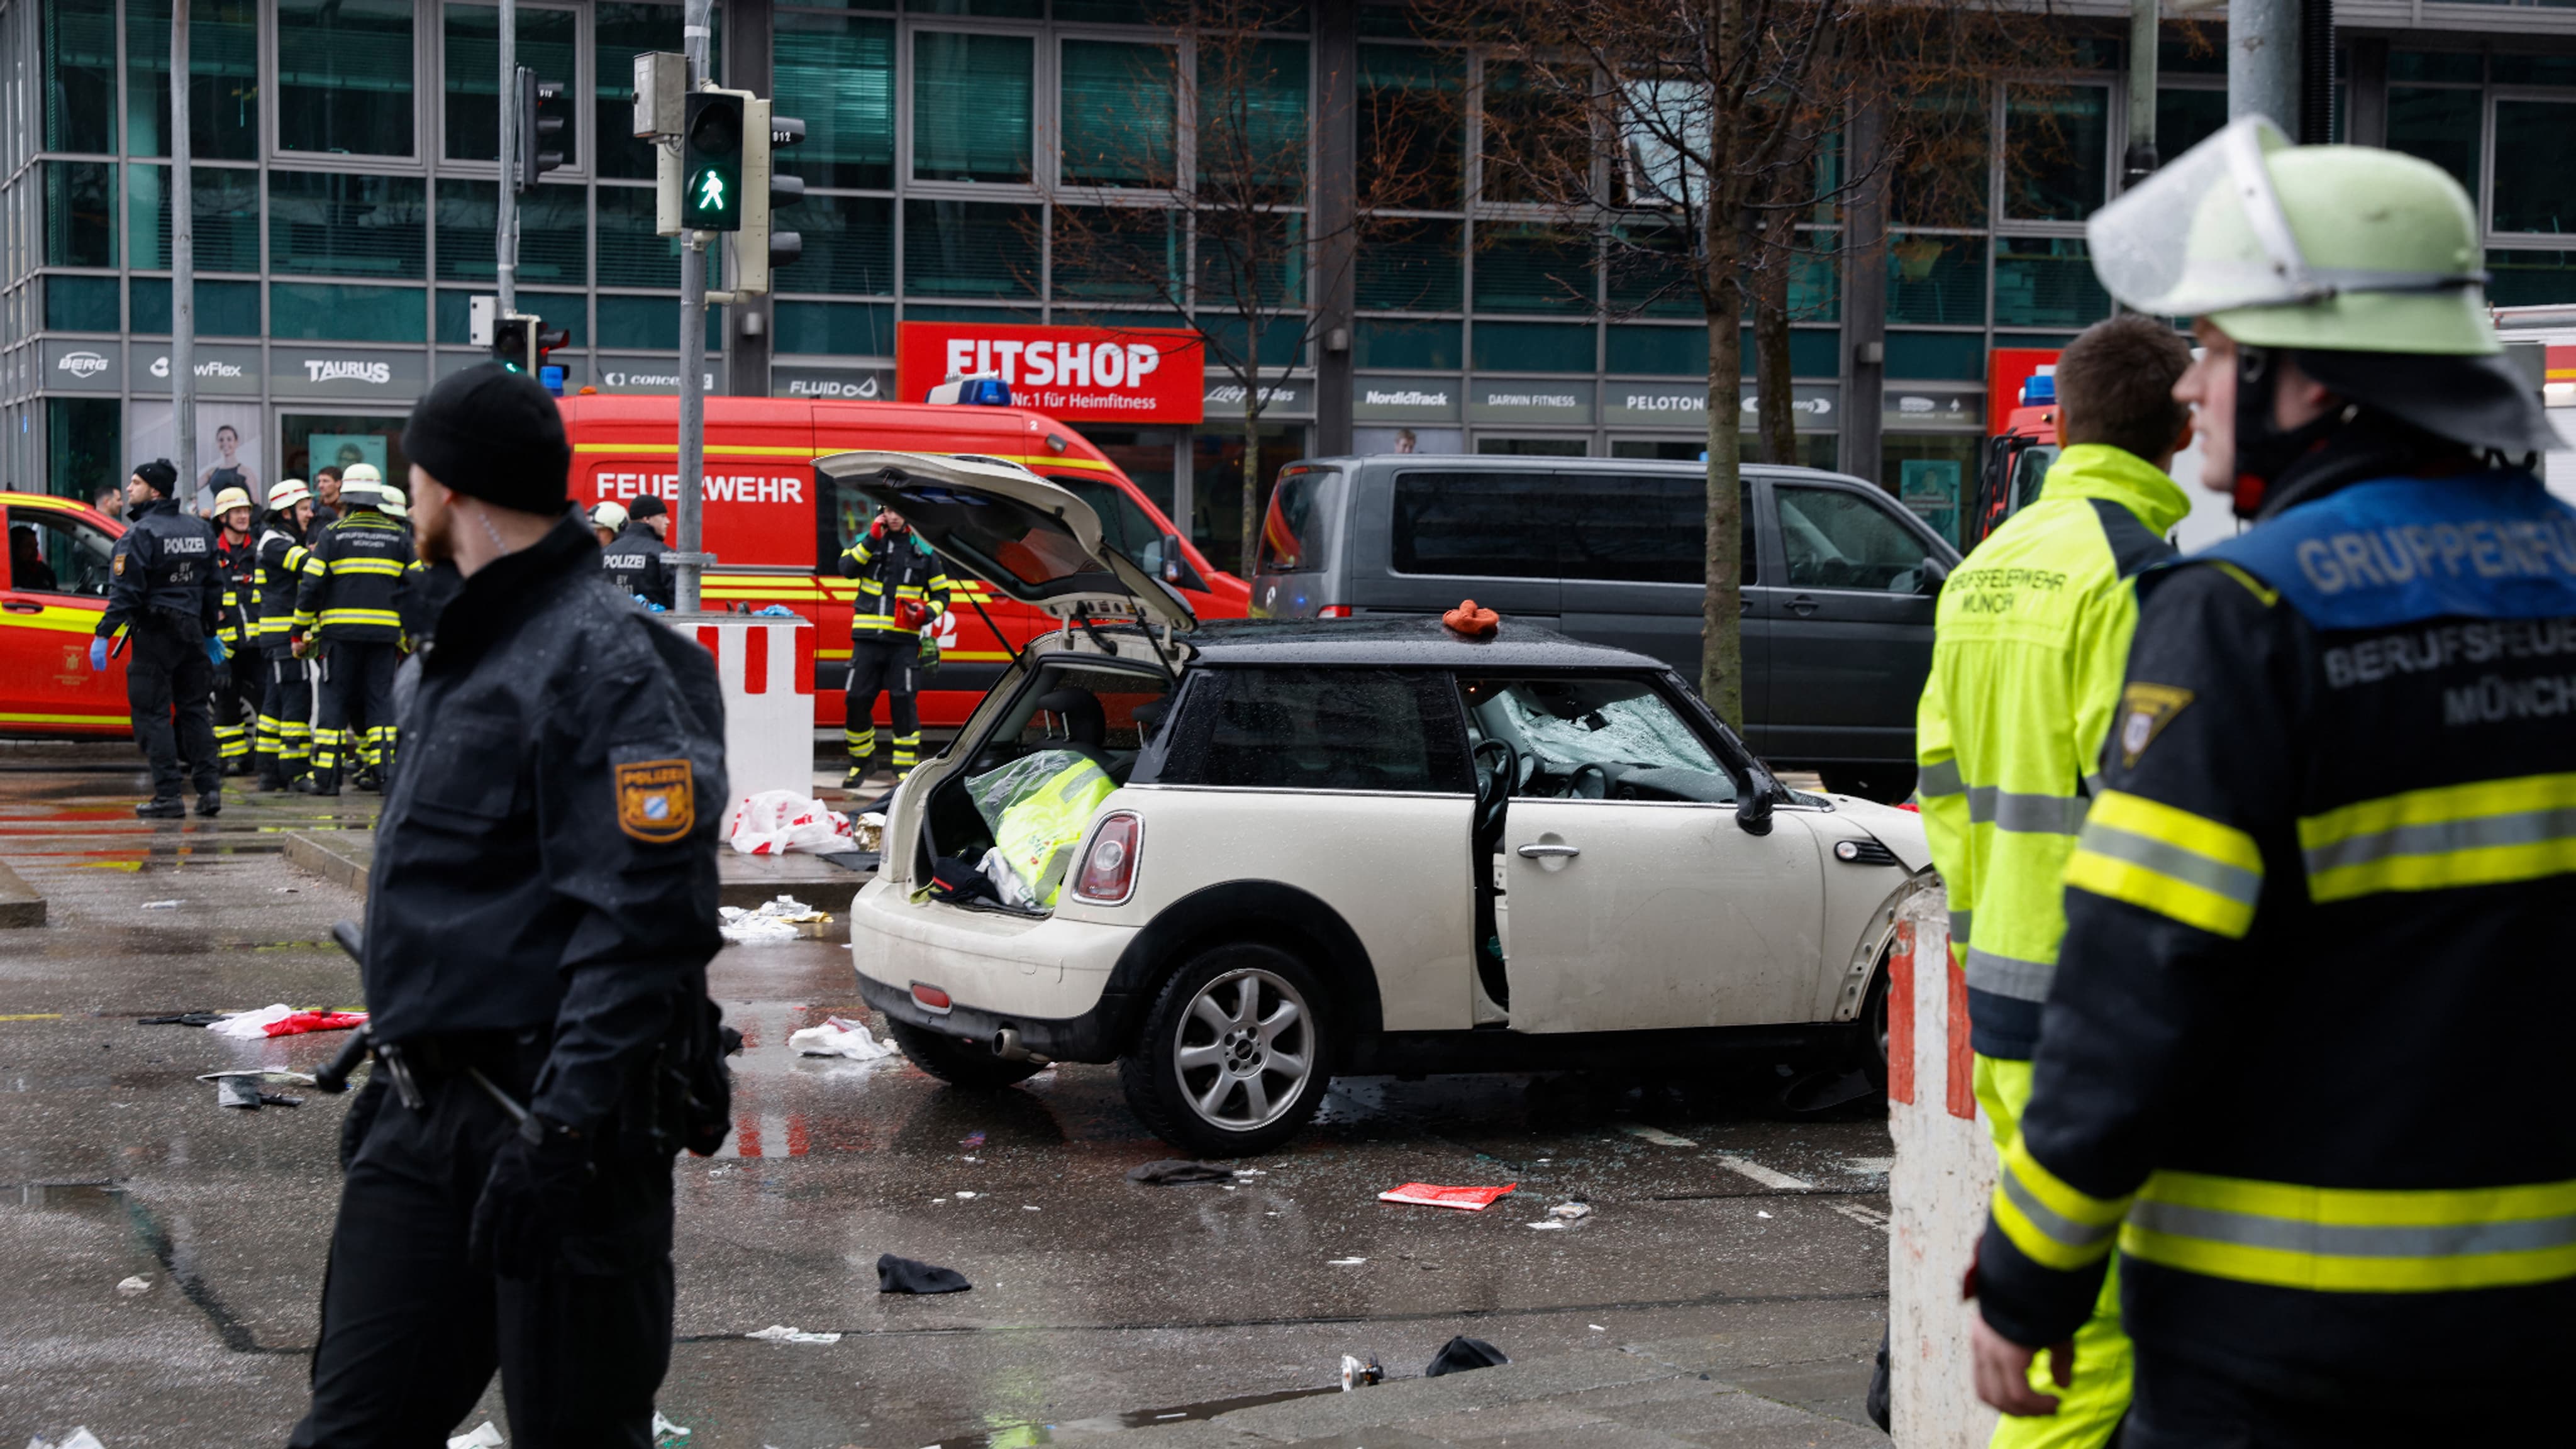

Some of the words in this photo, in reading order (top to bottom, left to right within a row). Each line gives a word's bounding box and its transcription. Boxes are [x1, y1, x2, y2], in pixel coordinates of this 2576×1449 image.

[58, 358, 108, 370] BERG
[194, 362, 242, 377] wFlex
[947, 339, 1160, 387] FITSHOP
[304, 360, 391, 384] TAURUS
[630, 375, 680, 386] conce
[790, 380, 841, 395] FLUID
[1044, 392, 1066, 408] für
[1070, 394, 1157, 409] Heimfitness
[1365, 391, 1448, 406] NordicTrack
[1488, 394, 1530, 406] DARWIN
[1532, 395, 1576, 408] FITNESS
[1626, 395, 1705, 411] PELOTON
[1030, 420, 1038, 431] 2
[597, 472, 804, 504] FEUEWEHR
[164, 537, 206, 554] POLIZEI
[603, 555, 646, 569] POLIZEI
[623, 768, 684, 786] POLIZEI
